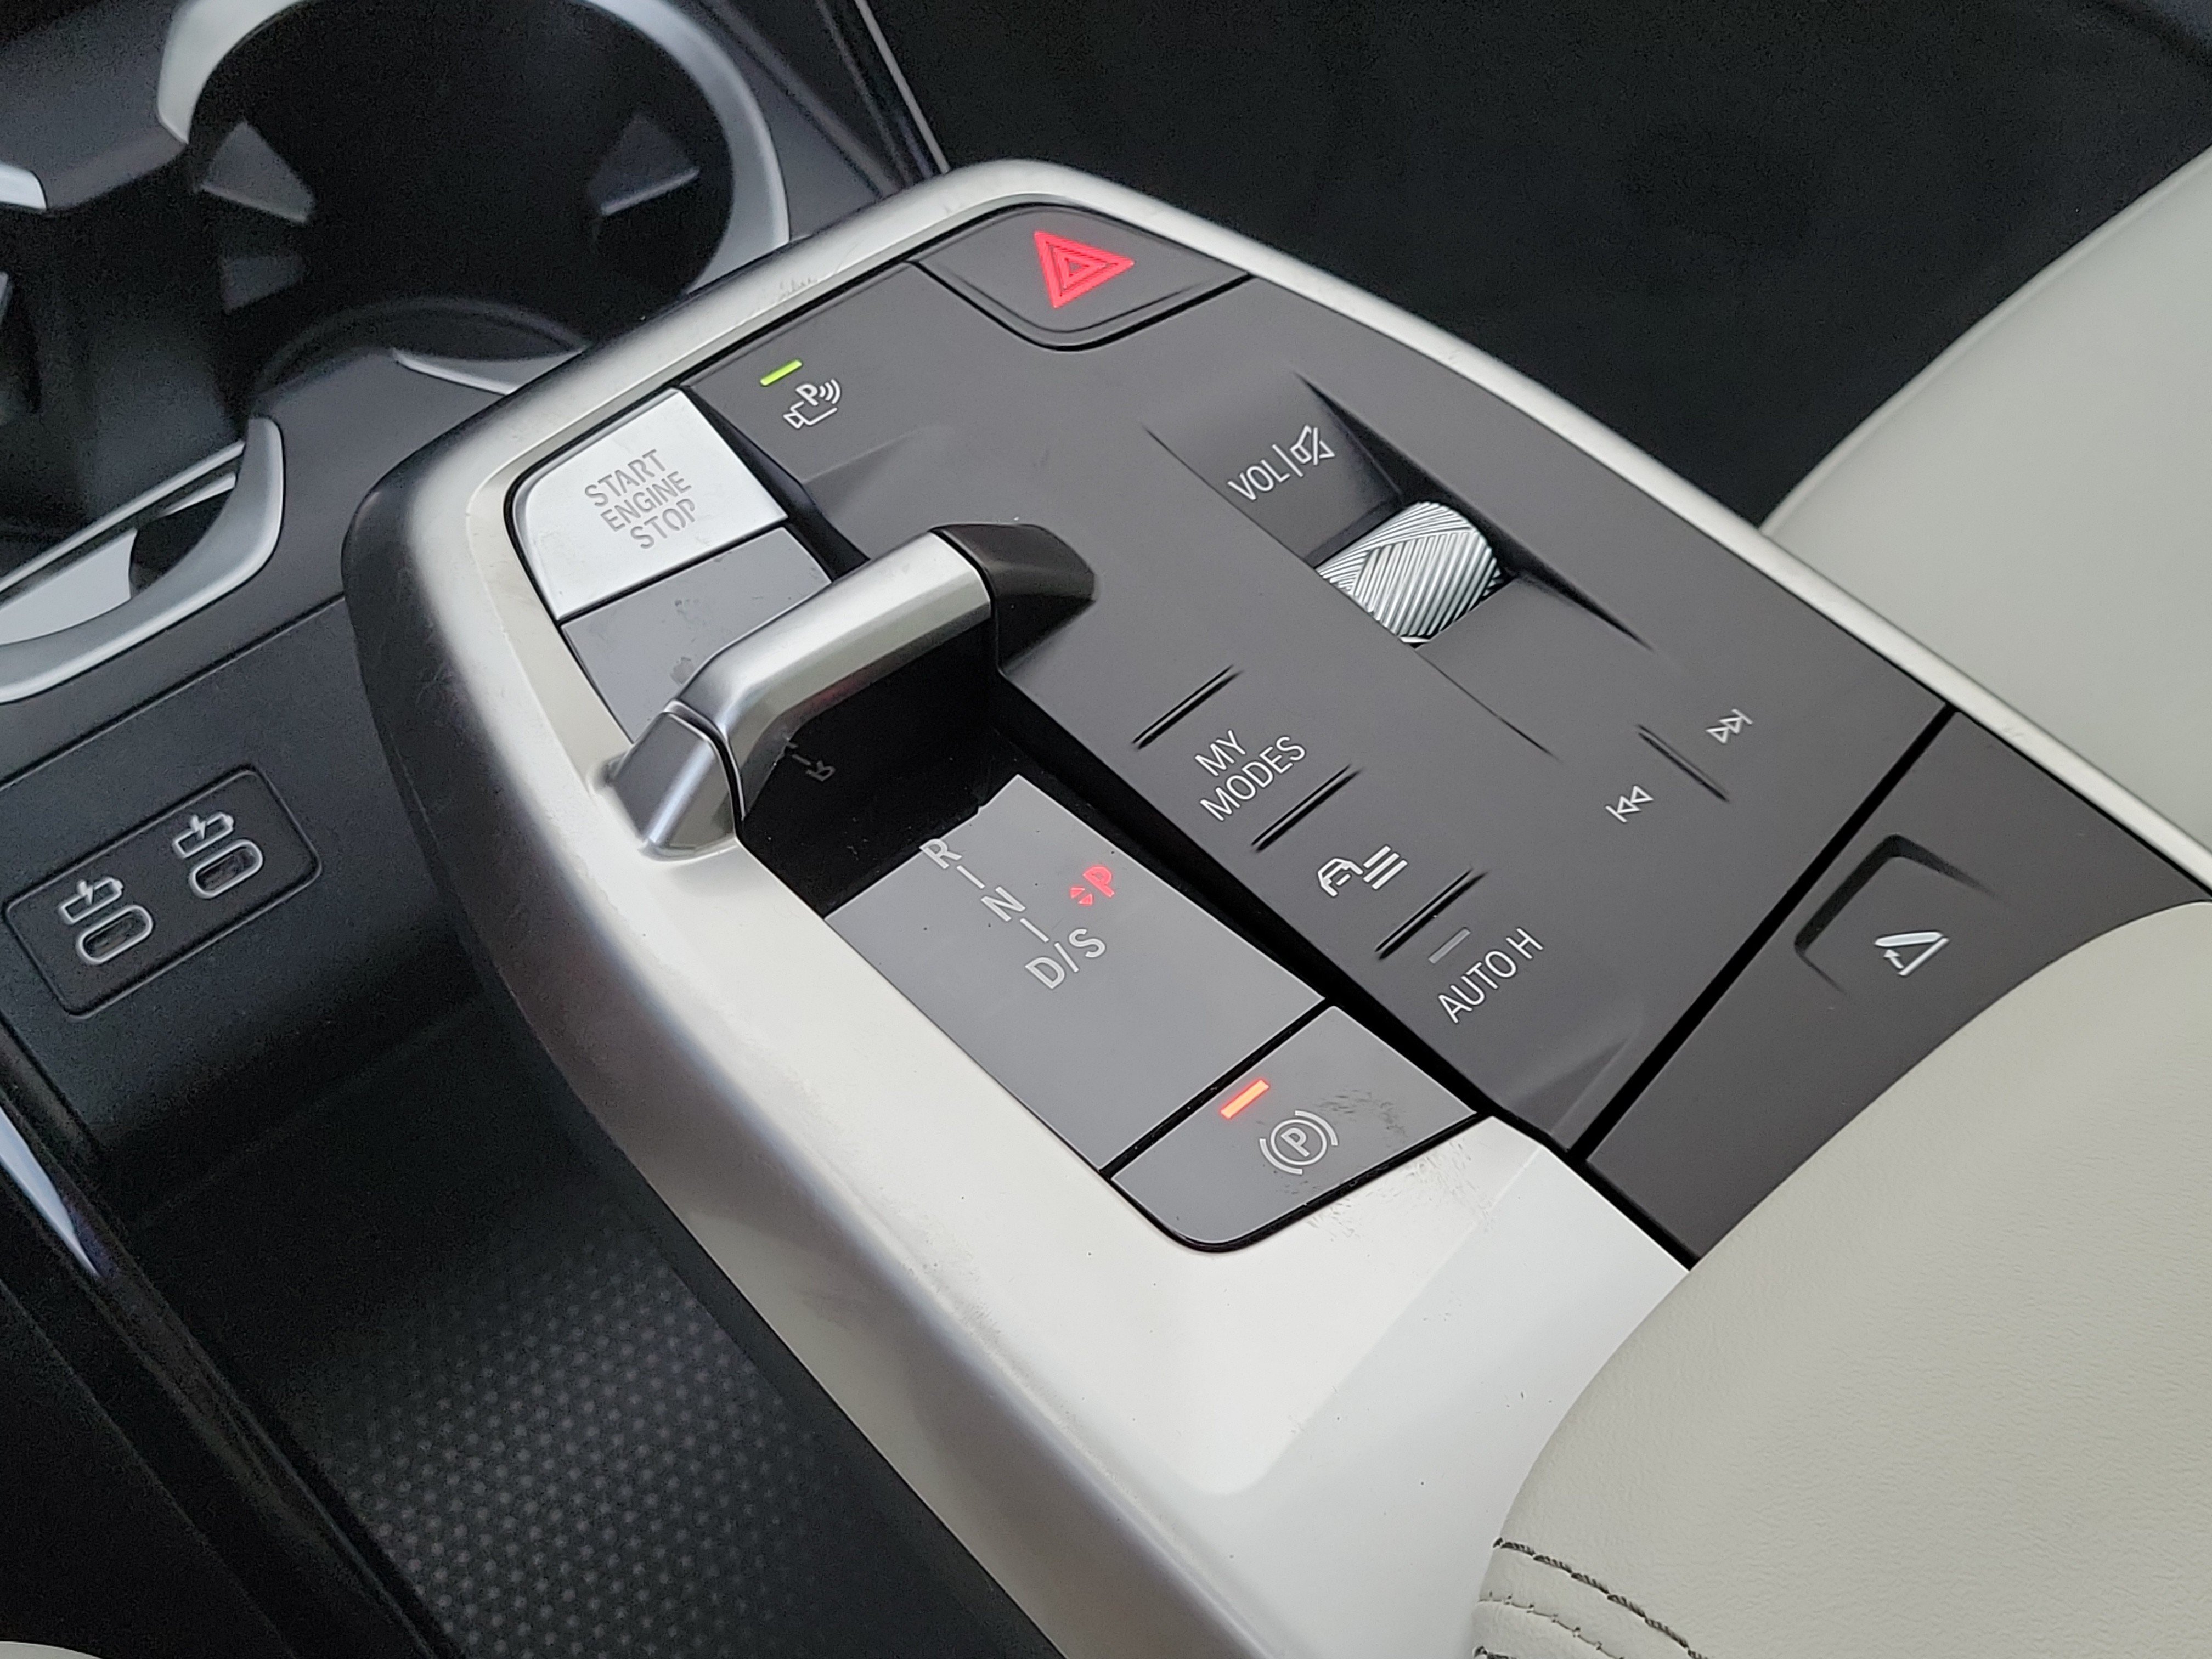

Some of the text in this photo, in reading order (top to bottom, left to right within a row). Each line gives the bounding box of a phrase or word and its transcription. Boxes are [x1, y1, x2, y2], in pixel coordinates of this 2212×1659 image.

[585, 449, 665, 507] START
[600, 471, 692, 532] ENGINE
[630, 499, 696, 549] STOP
[1195, 730, 1246, 777] MY
[1200, 736, 1306, 821] MODES
[919, 838, 962, 870] R
[981, 885, 1026, 922] N
[1082, 865, 1115, 898] P
[1025, 928, 1107, 989] D/S
[1438, 927, 1544, 1024] AUTO H
